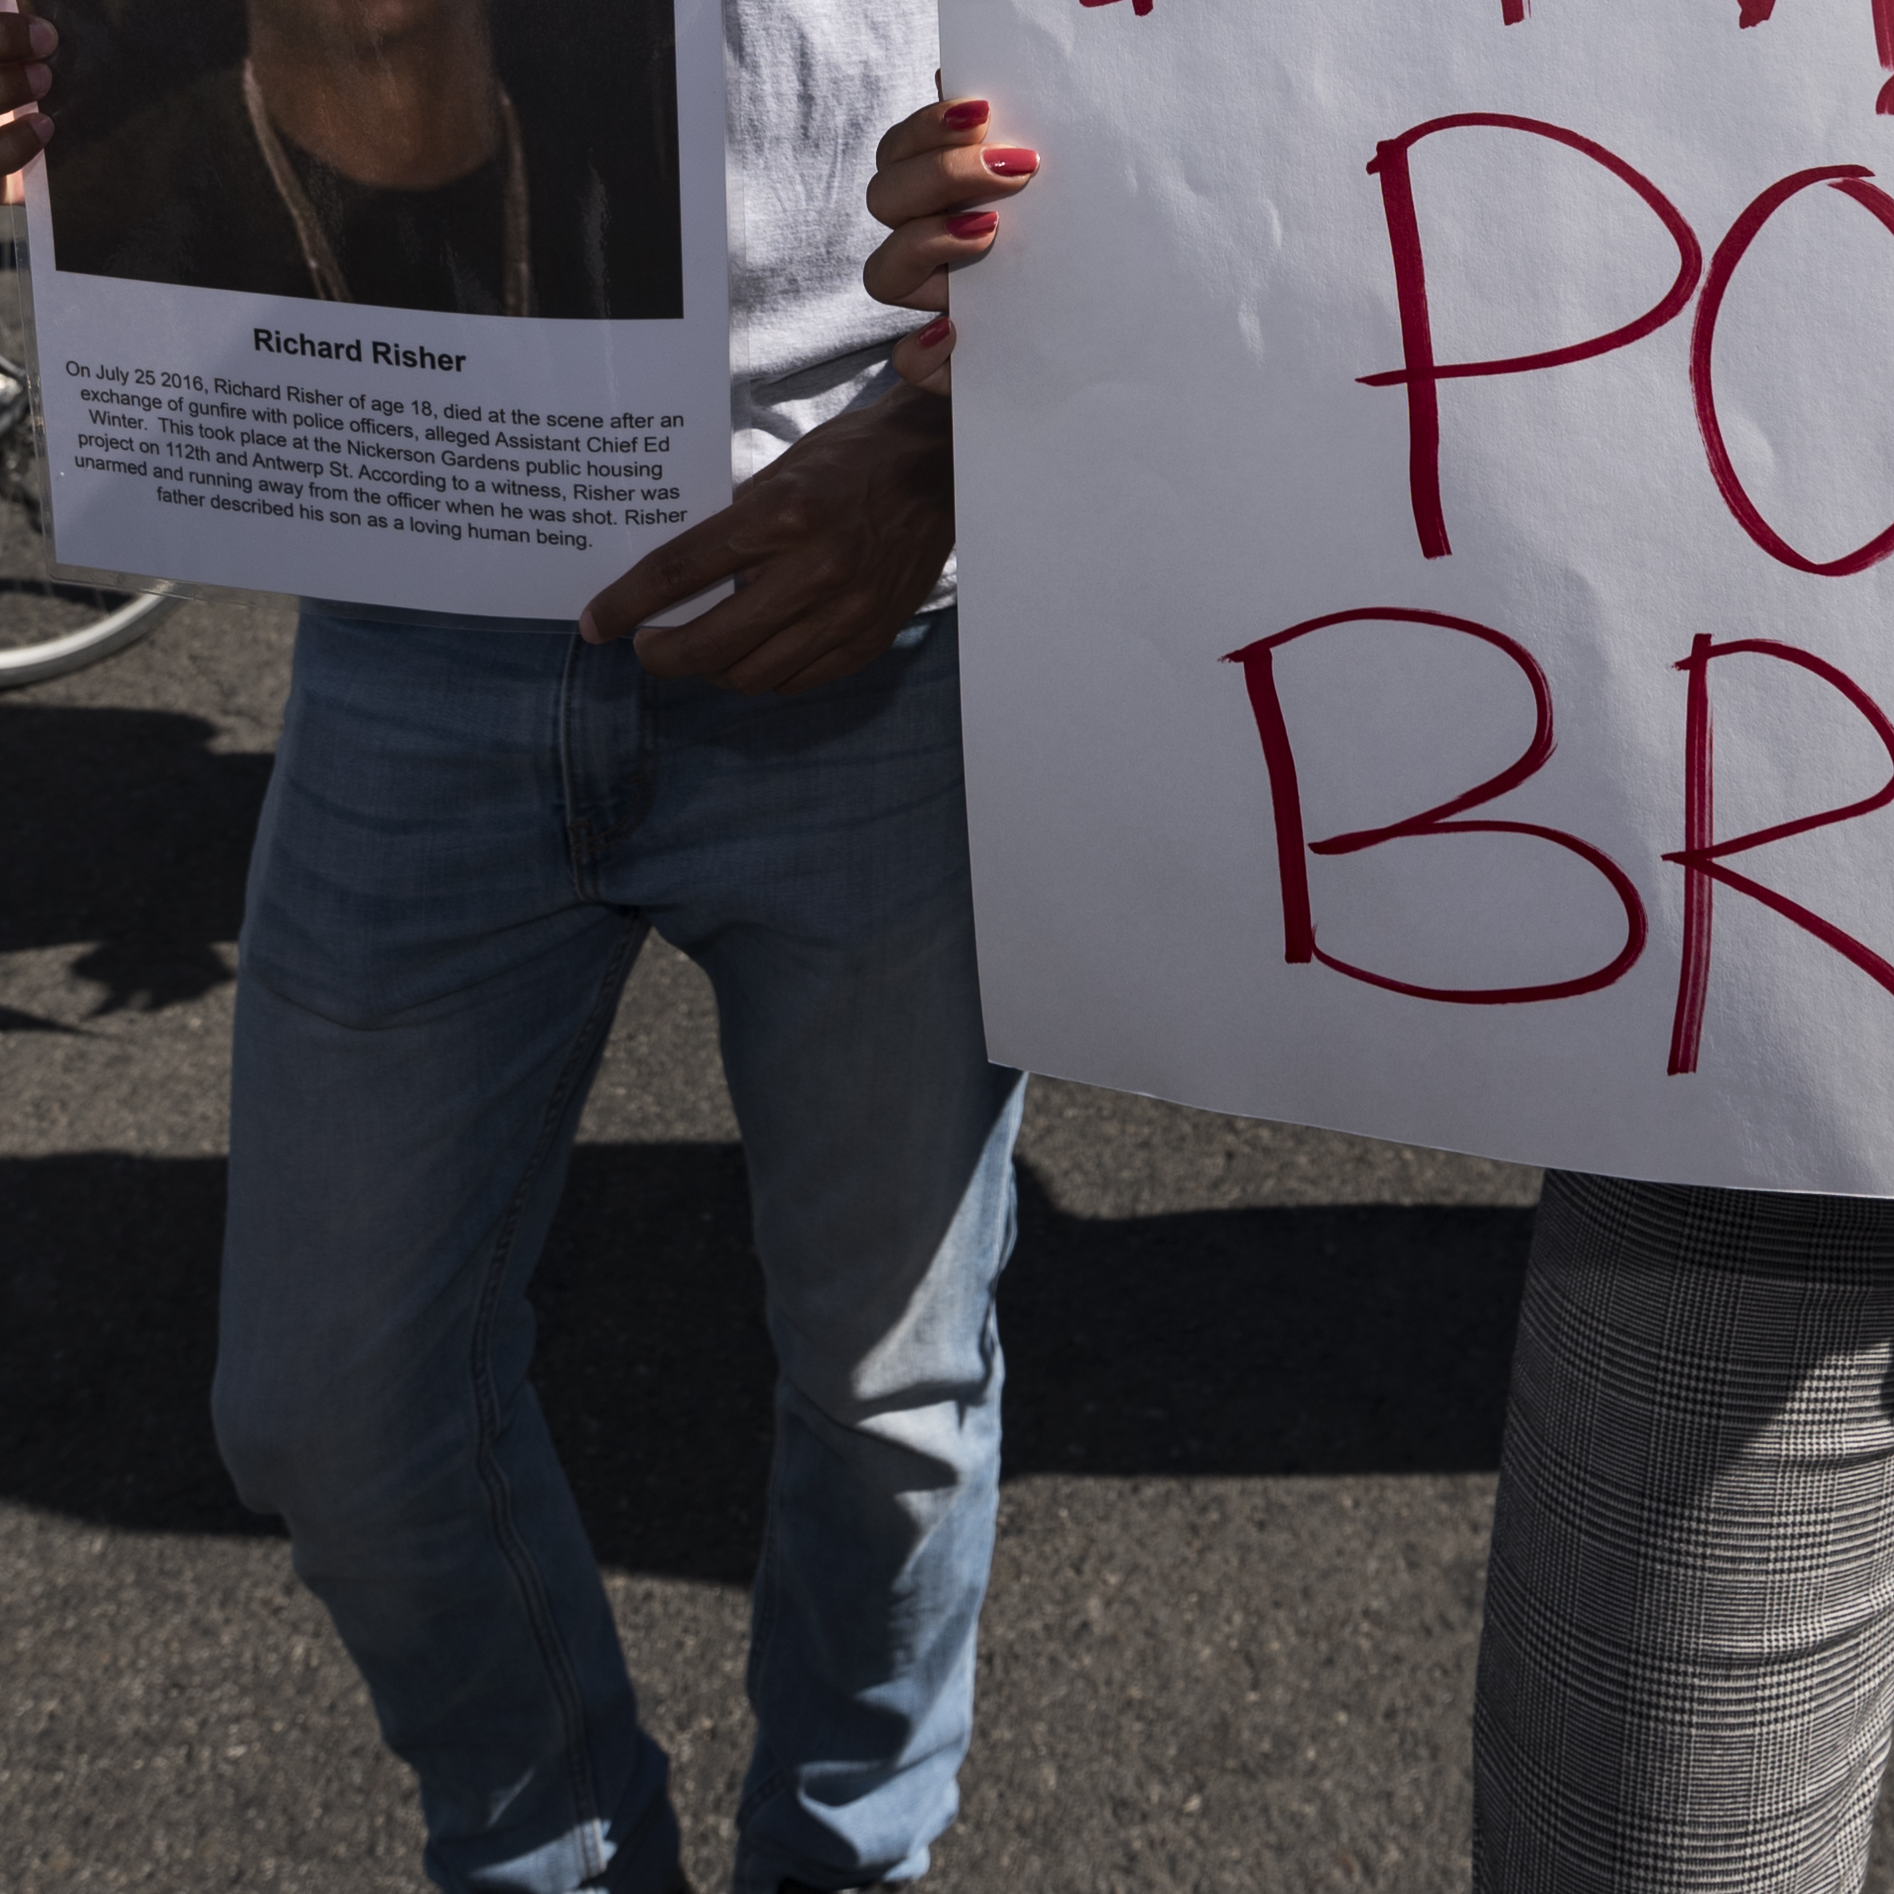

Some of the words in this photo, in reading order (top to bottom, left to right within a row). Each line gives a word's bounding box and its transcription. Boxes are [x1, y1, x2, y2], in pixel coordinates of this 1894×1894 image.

[254, 328, 362, 362] Richard
[372, 341, 467, 372] Risher
[65, 360, 91, 378] On
[95, 364, 129, 386] July
[134, 368, 156, 386] 25
[161, 371, 208, 395] 2016,
[214, 378, 281, 400] Richard
[287, 386, 344, 407] Risher
[349, 394, 366, 410] of
[371, 399, 404, 416] age
[411, 400, 438, 420] 18,
[443, 403, 482, 422] died
[488, 408, 506, 424] at
[511, 409, 540, 426] the
[546, 414, 604, 429] scene
[610, 412, 655, 429] after
[660, 415, 684, 428] an
[80, 388, 162, 412] exchange
[167, 396, 184, 412] of
[188, 402, 247, 420] gunfire
[251, 407, 287, 424] with
[293, 412, 344, 431] police
[349, 418, 419, 442] officers,
[425, 425, 490, 448] alleged
[495, 431, 581, 452] Assistant
[587, 436, 638, 453] Chief
[644, 436, 670, 453] Ed
[78, 433, 135, 452] project
[139, 441, 160, 455] on
[166, 441, 210, 462] 112th
[216, 451, 248, 467] and
[252, 452, 324, 478] Antwerp
[329, 461, 353, 479] St.
[358, 464, 446, 493] According
[452, 475, 469, 491] to
[475, 480, 486, 493] a
[491, 479, 566, 502] witness,
[573, 484, 636, 501] Risher
[640, 487, 680, 501] was
[88, 409, 148, 431] Winter.
[157, 417, 194, 436] This
[198, 423, 235, 442] took
[240, 429, 287, 447] place
[293, 435, 309, 451] at
[314, 436, 341, 454] the
[347, 439, 435, 464] Nickerson
[441, 450, 520, 472] Gardens
[526, 458, 581, 477] public
[587, 460, 662, 481] housing
[74, 455, 147, 476] unarmed
[153, 466, 183, 481] and
[189, 471, 252, 494] running
[258, 480, 304, 499] away
[308, 482, 348, 501] from
[353, 487, 381, 505] the
[387, 492, 441, 512] officer
[445, 498, 494, 517] when
[500, 502, 523, 519] he
[528, 508, 566, 522] was
[572, 508, 618, 525] shot.
[625, 508, 688, 525] Risher
[157, 486, 206, 507] father
[210, 494, 294, 517] described
[299, 503, 324, 521] his
[329, 511, 361, 526] son
[367, 515, 388, 528] as
[393, 518, 404, 530] a
[410, 516, 462, 541] loving
[468, 522, 530, 543] human
[536, 528, 593, 551] being.
